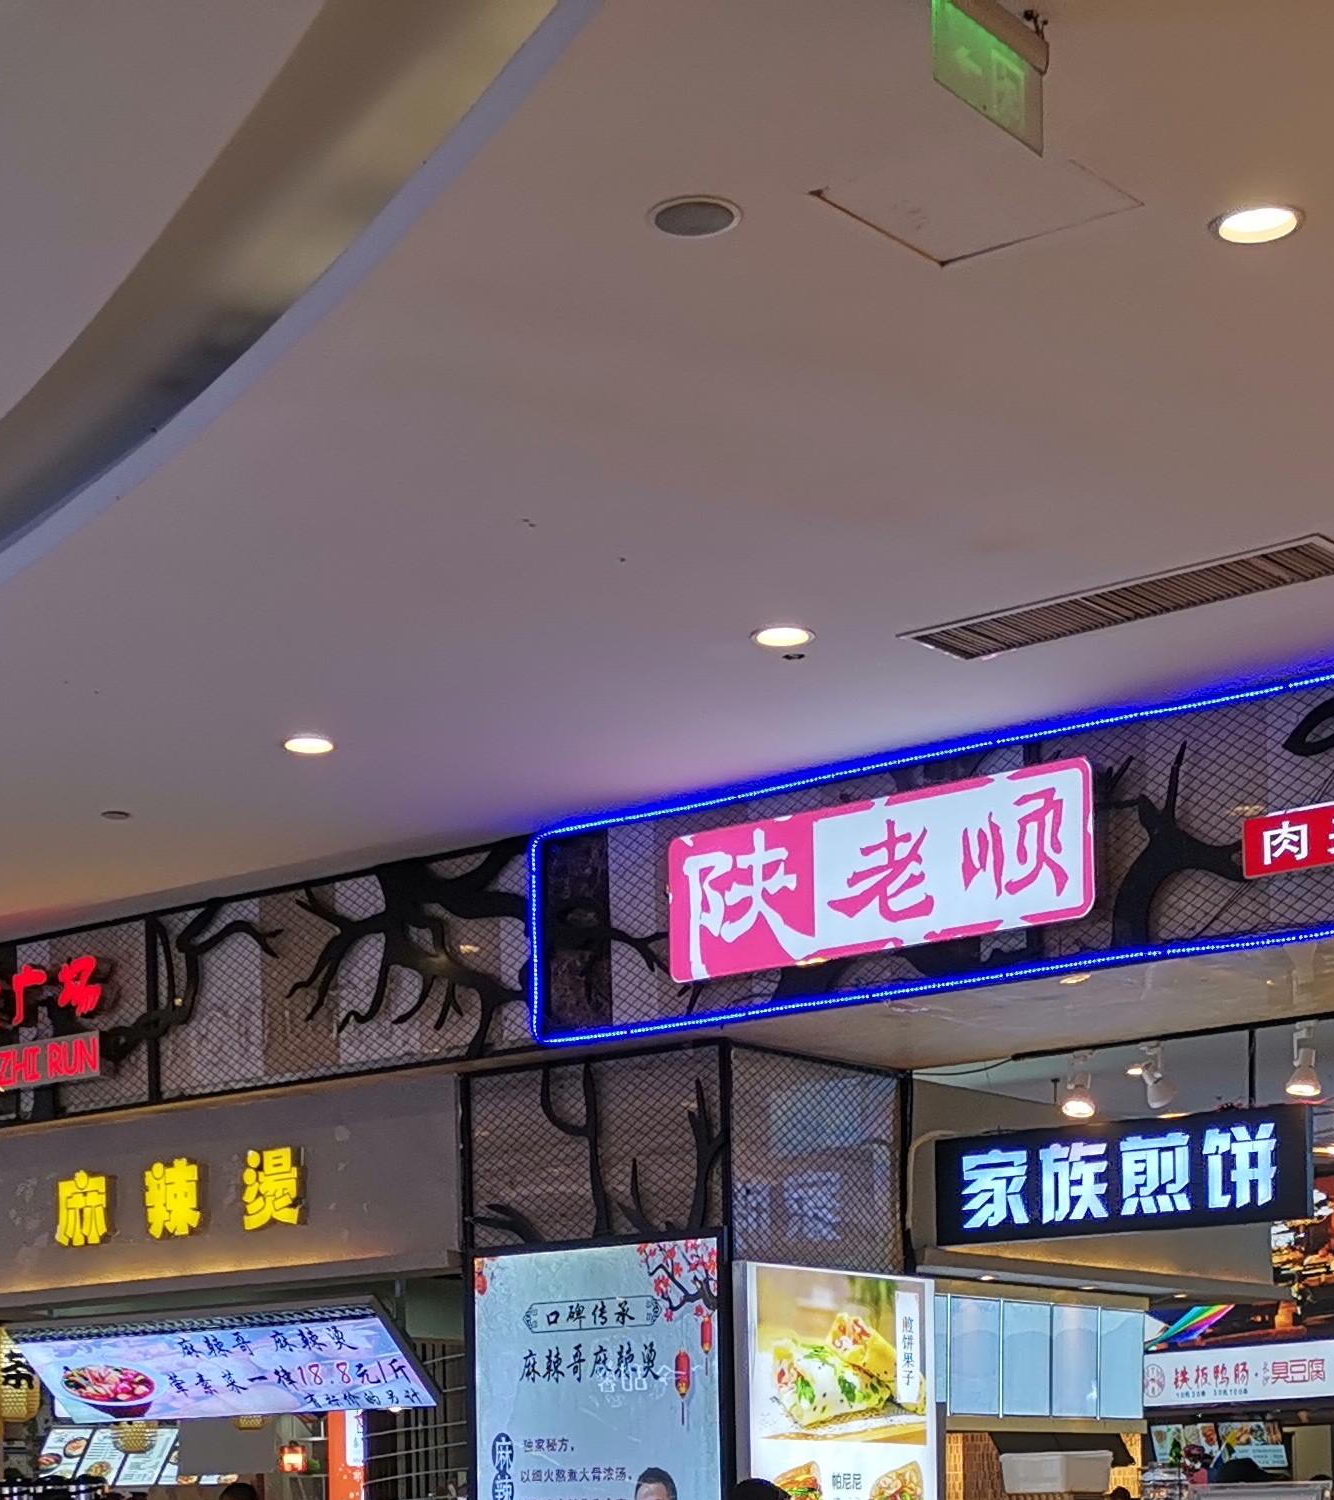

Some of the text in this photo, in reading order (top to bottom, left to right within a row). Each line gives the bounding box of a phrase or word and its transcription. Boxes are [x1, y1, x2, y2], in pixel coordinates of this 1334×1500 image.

[683, 785, 1068, 978] 陕老顺
[47, 1036, 98, 1078] RUN
[959, 1121, 1278, 1229] 家族煎饼
[545, 1300, 636, 1329] 口碑传承
[902, 1316, 915, 1386] 煎饼果子
[831, 1472, 862, 1491] 帕尼尼
